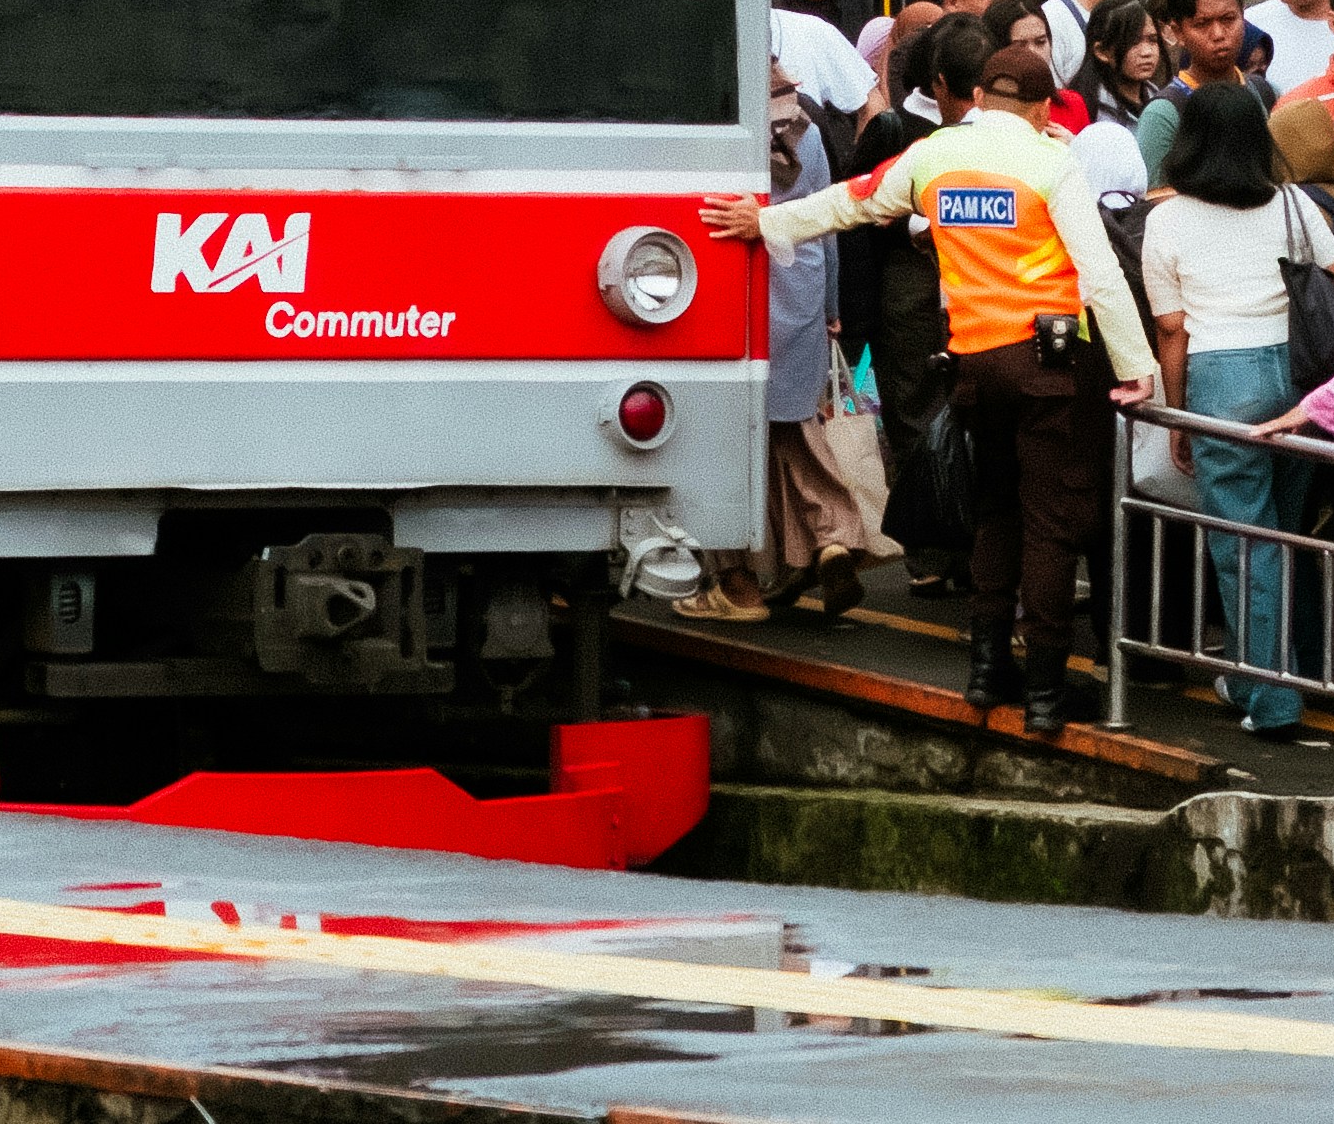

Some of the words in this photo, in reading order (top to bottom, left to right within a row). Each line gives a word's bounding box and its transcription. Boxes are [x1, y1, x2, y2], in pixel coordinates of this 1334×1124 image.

[940, 195, 978, 219] PAM
[981, 196, 1013, 221] KCI
[151, 212, 312, 293] KAI
[265, 301, 456, 338] Commuter
